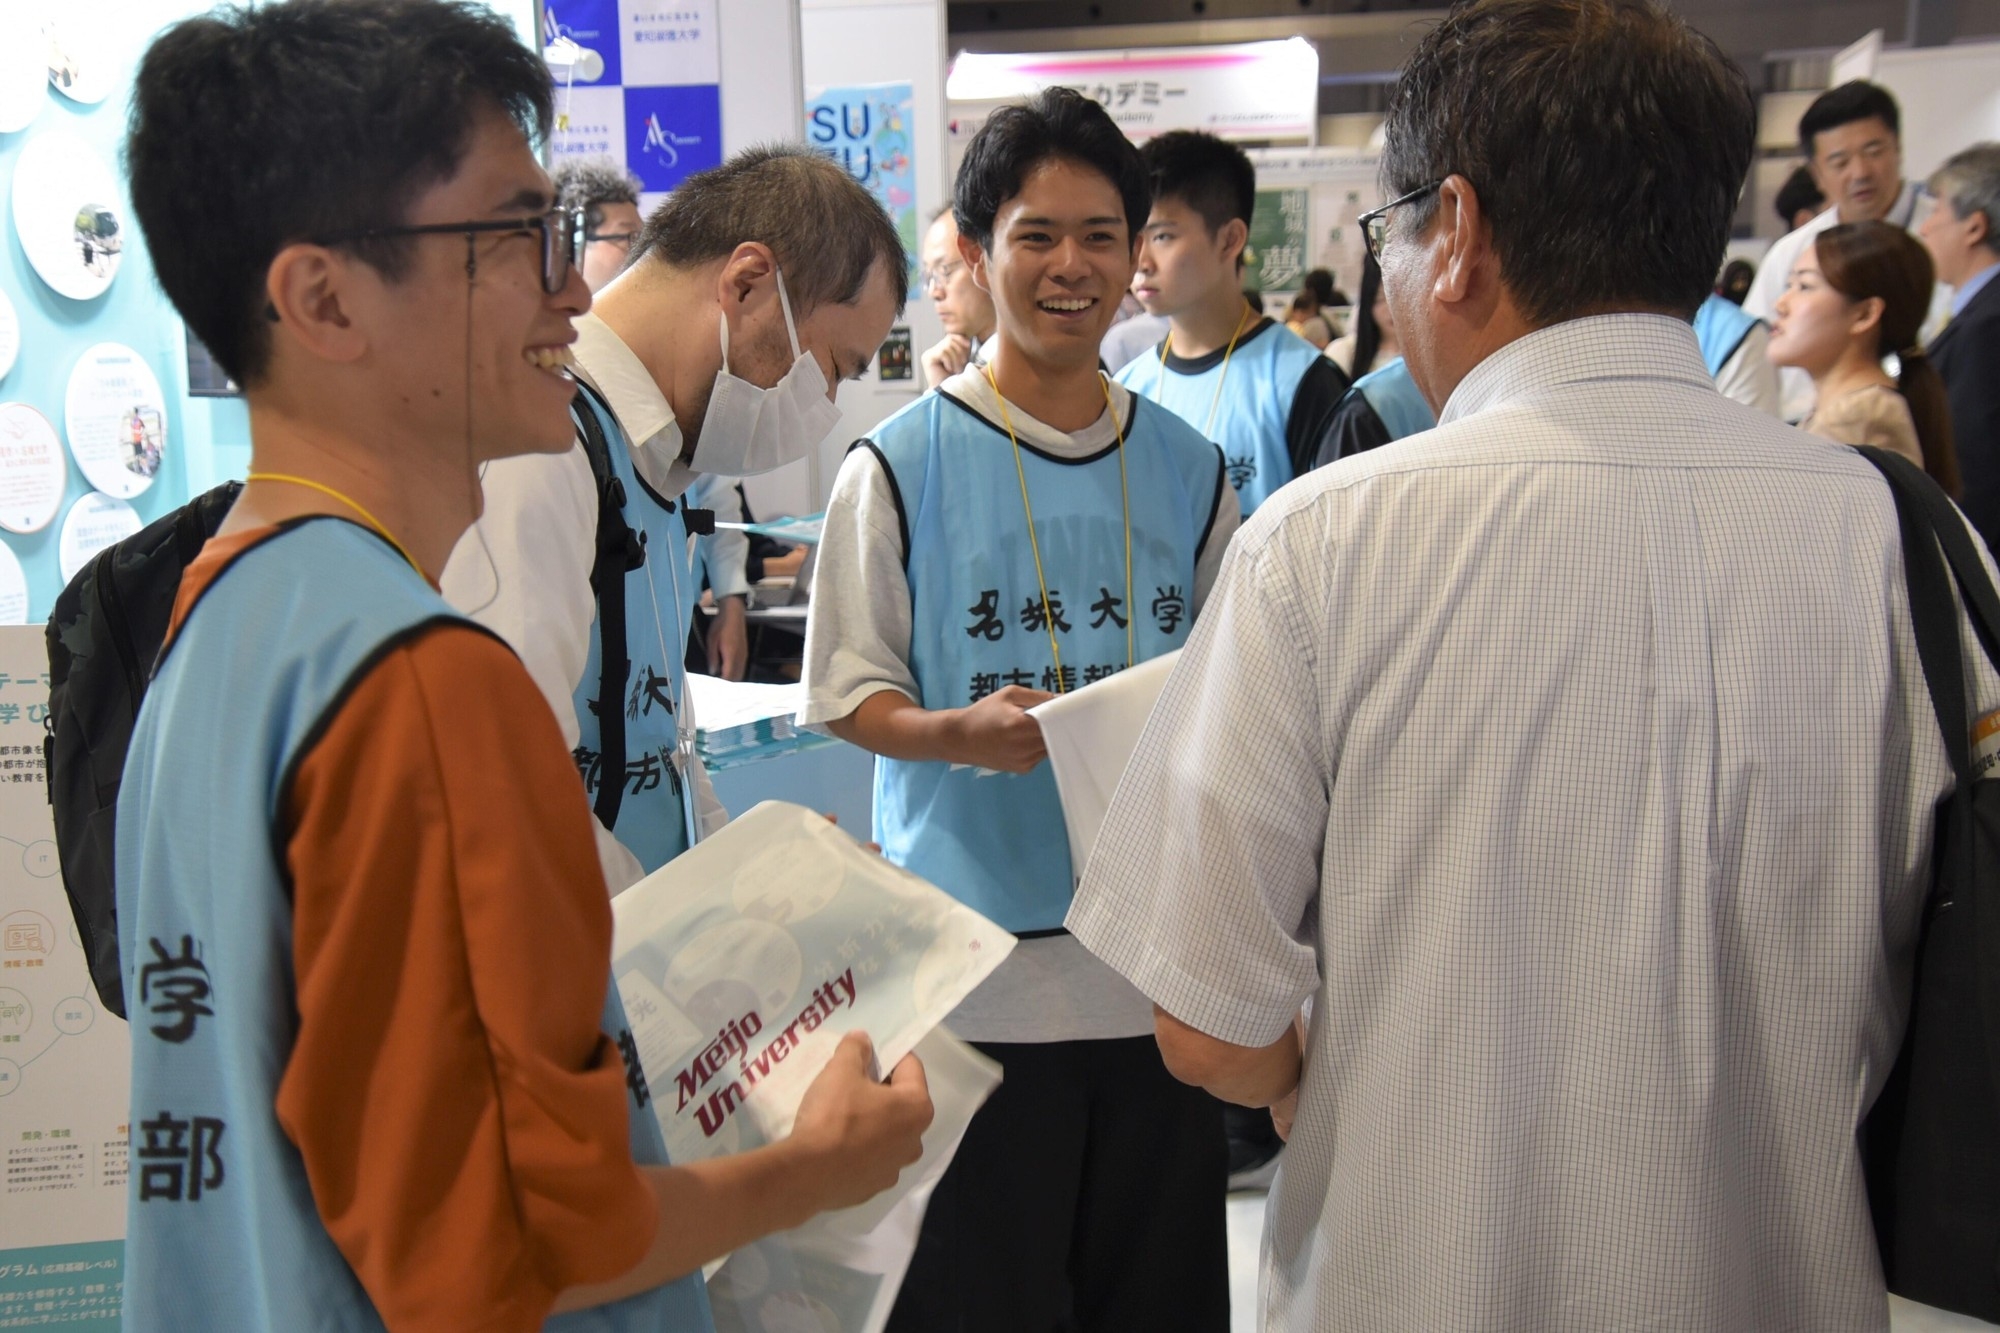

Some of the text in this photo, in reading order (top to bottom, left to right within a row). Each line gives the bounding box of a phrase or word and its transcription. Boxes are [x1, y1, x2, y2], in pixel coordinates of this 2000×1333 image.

[1062, 80, 1186, 106] カデミー
[813, 103, 870, 142] SU
[1226, 456, 1257, 491] 学
[966, 584, 1187, 642] 名城大学
[969, 663, 1133, 704] 都市情報
[138, 935, 225, 1202] 学部
[675, 1010, 762, 1114] Meijo
[692, 966, 858, 1138] University
